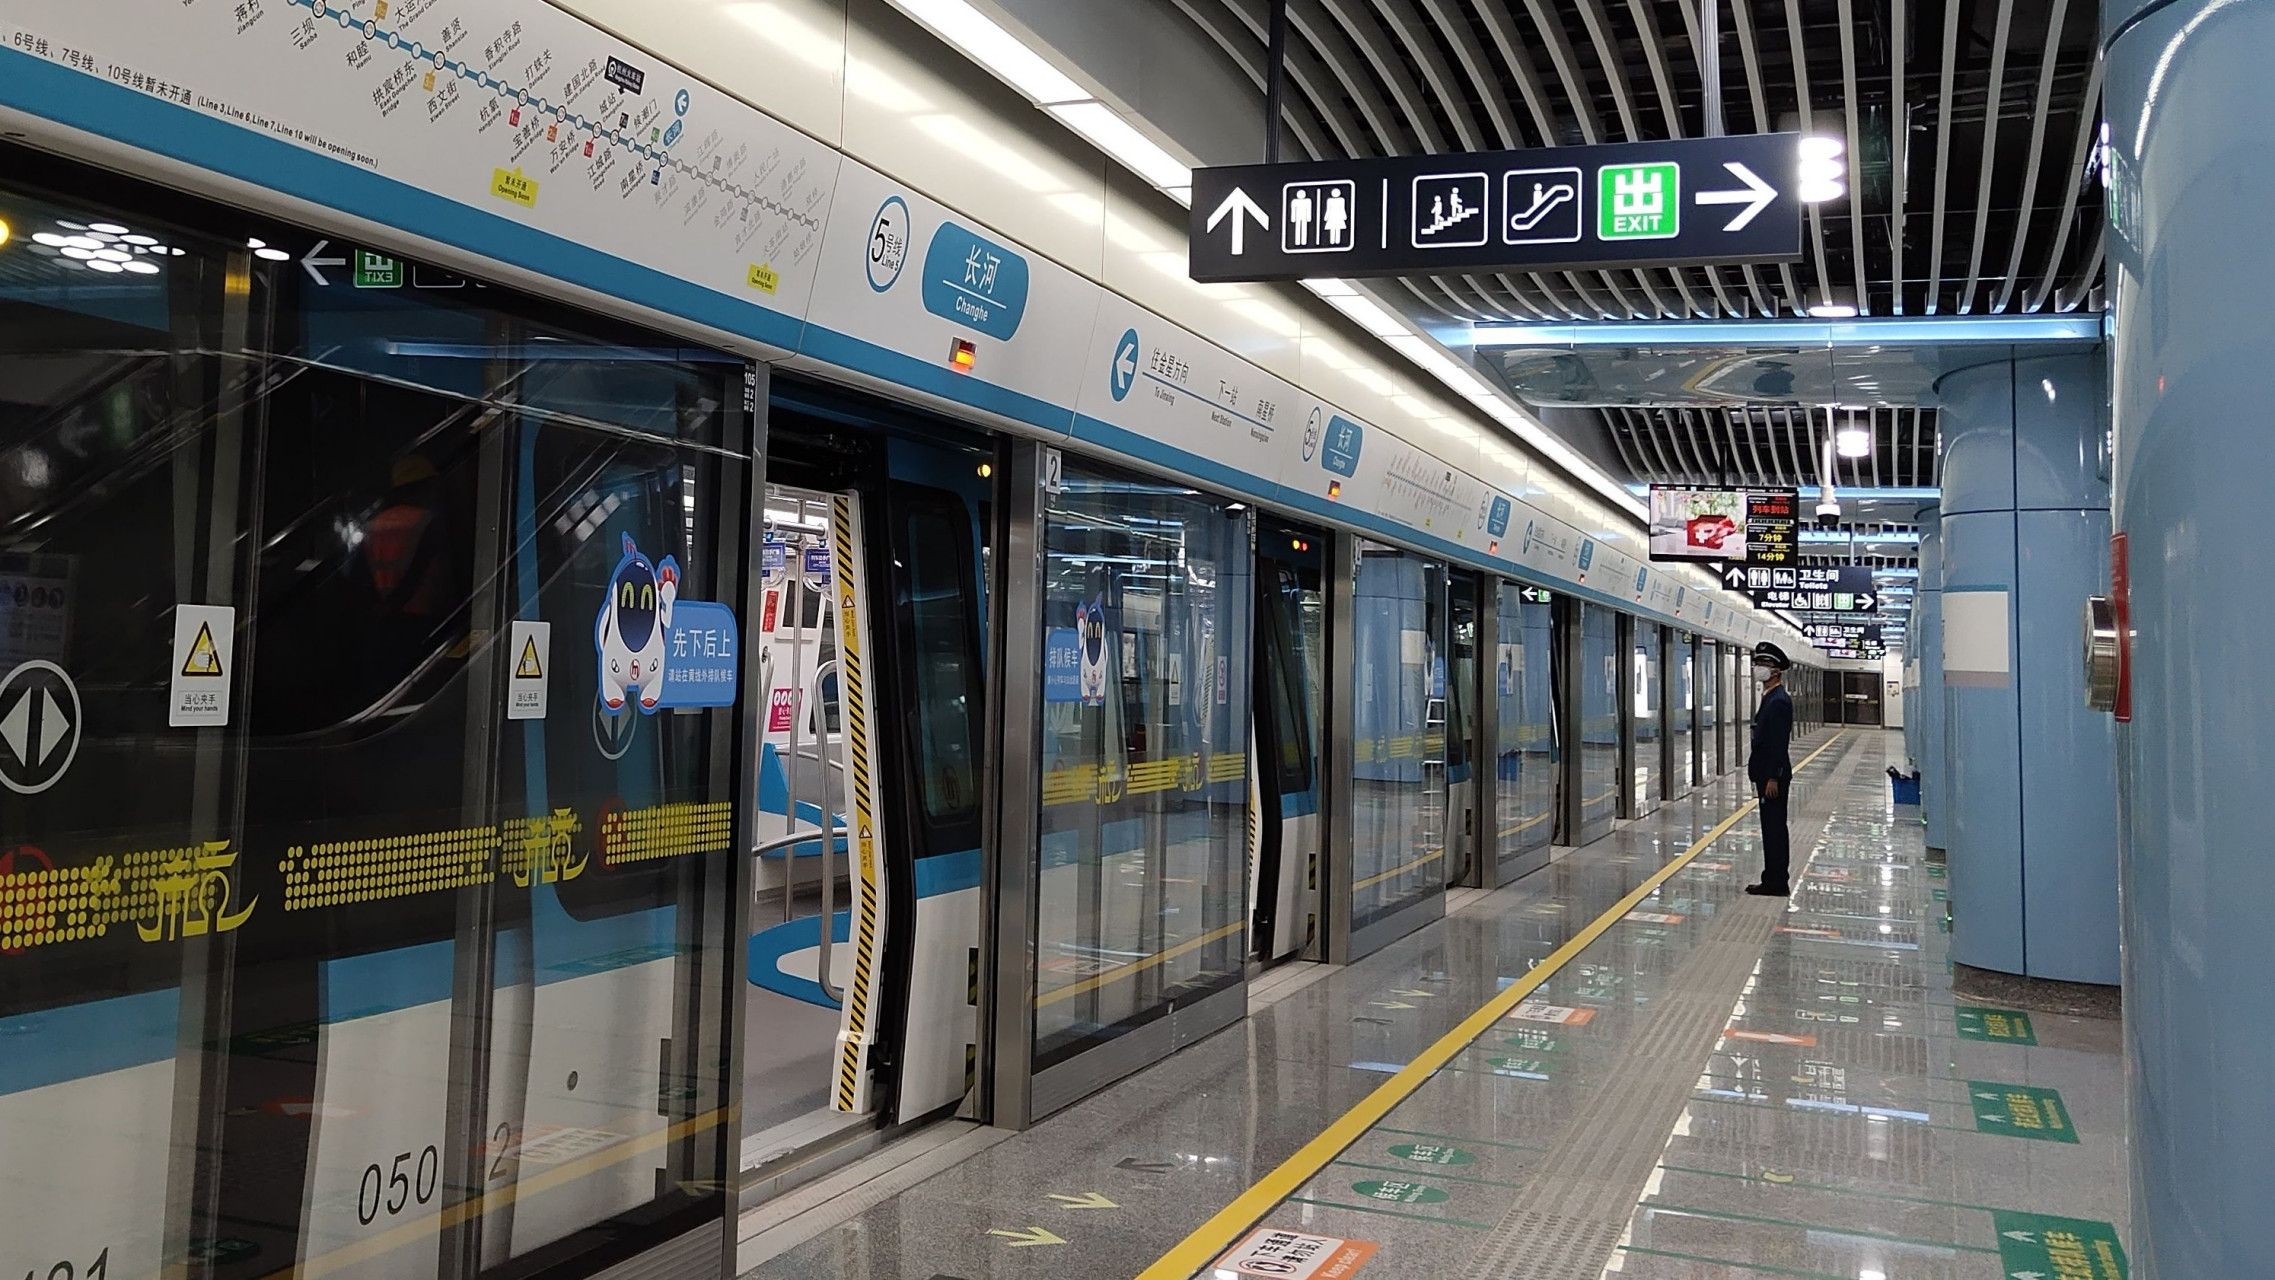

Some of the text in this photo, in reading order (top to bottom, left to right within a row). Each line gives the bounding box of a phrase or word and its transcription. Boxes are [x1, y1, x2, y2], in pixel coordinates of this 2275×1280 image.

[291, 17, 315, 46] 三坝
[1614, 214, 1663, 233] EXIT
[881, 254, 900, 272] Line 5
[964, 244, 1001, 295] 长河
[956, 295, 989, 323] Changhe
[1150, 347, 1190, 384] 往金星方向
[744, 372, 756, 387] 105
[1218, 379, 1238, 407] 下一站
[1049, 456, 1057, 487] 2
[1799, 569, 1839, 582] 卫生间
[1767, 591, 1790, 601] 电梯
[673, 627, 731, 659] 先下后上
[1049, 647, 1079, 669] 排队候车
[184, 693, 216, 705] 当心夹手
[357, 1121, 511, 1226] 050 2
[1372, 1180, 1411, 1201] 候车区
[1250, 1232, 1298, 1258] 下车通道
[1280, 1238, 1327, 1264] 请勿站人
